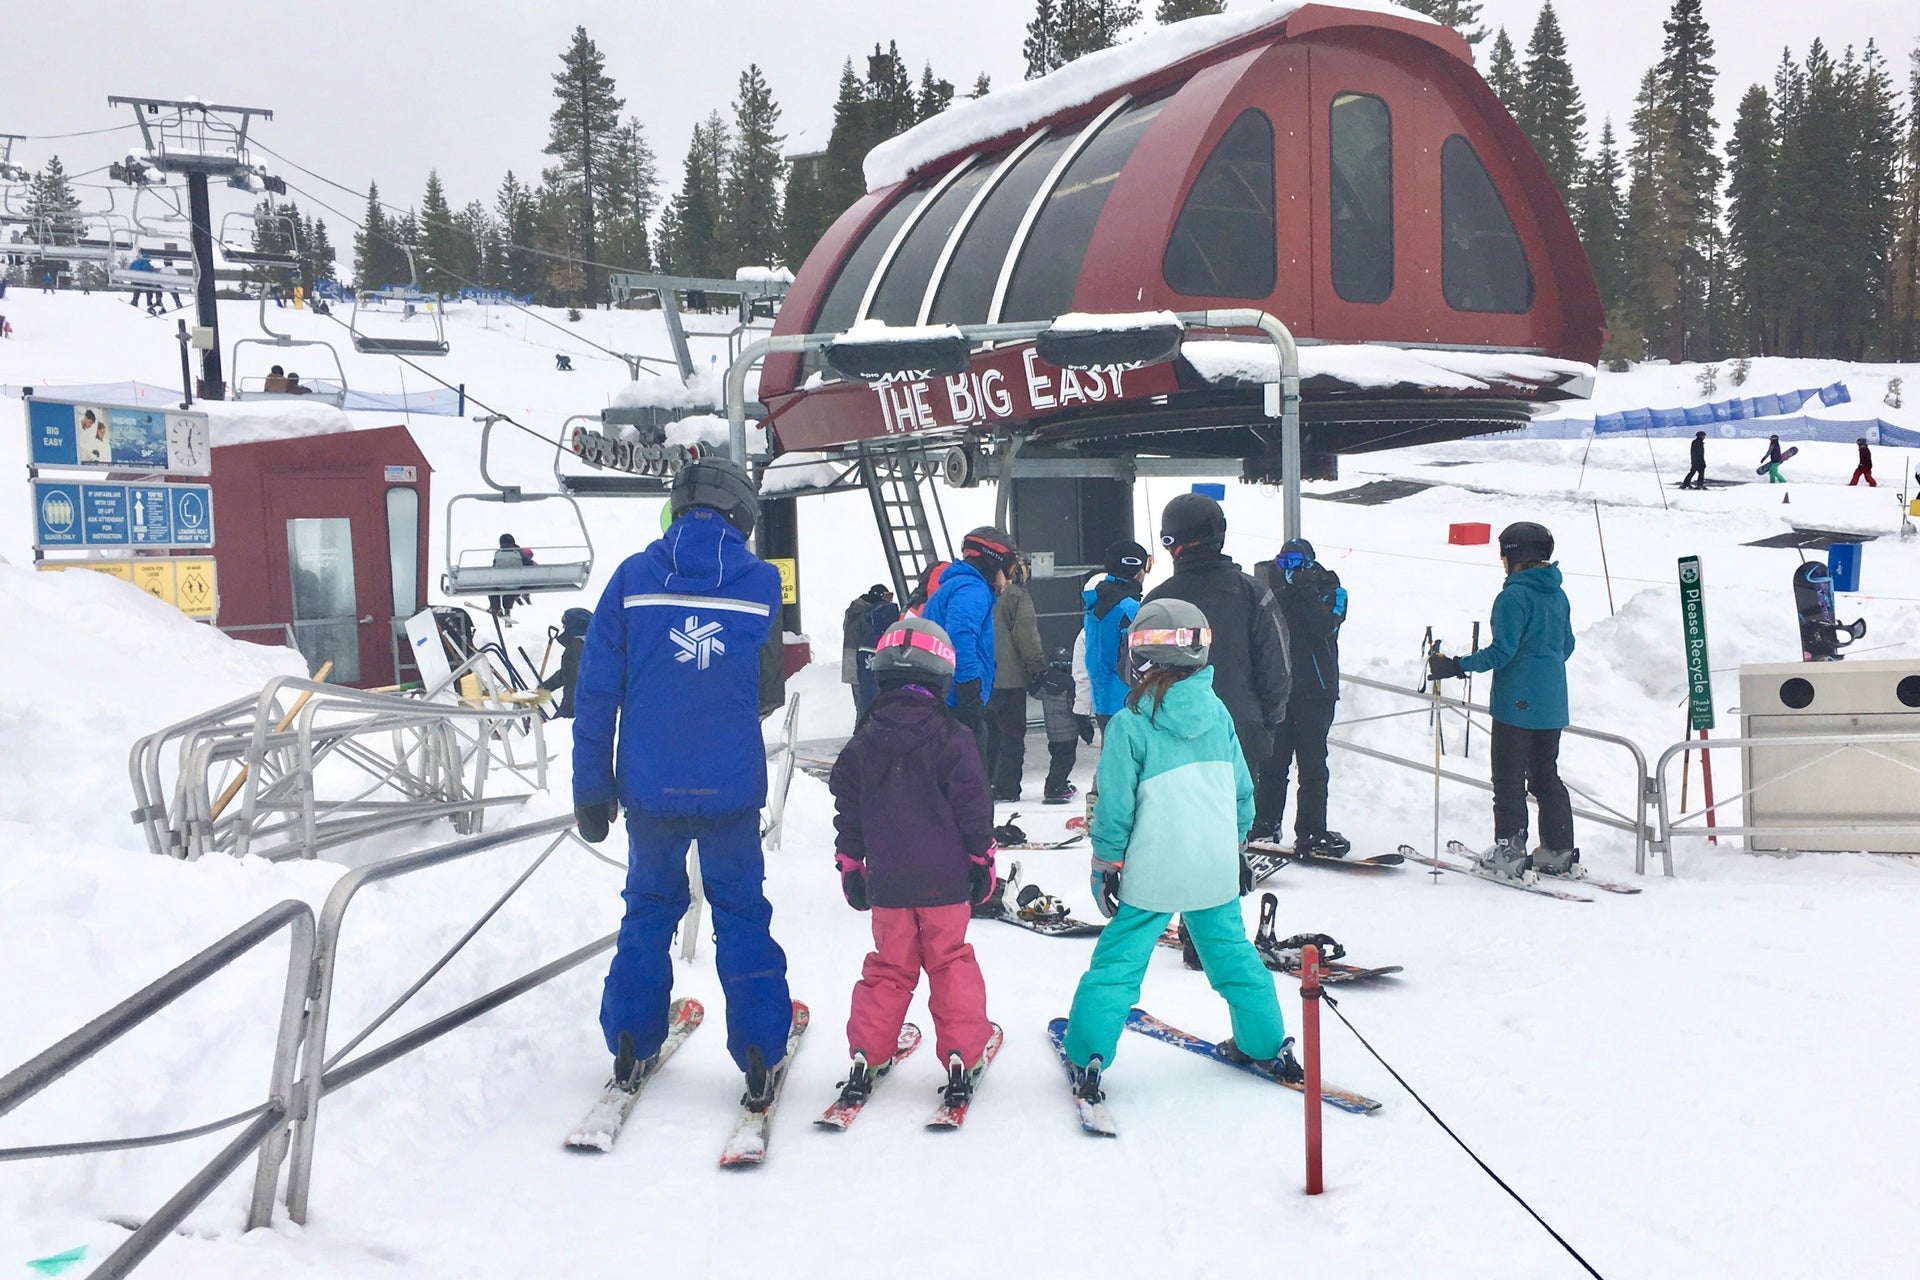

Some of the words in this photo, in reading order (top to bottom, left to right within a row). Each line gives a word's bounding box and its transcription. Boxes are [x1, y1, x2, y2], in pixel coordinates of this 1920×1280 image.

[878, 368, 935, 382] MIX
[869, 381, 937, 433] THE
[945, 368, 1013, 424] BIG
[1022, 348, 1124, 410] EASY
[43, 438, 64, 448] EASY
[46, 426, 60, 436] BIG
[1686, 589, 1700, 635] Please
[1690, 639, 1708, 694] Recycle
